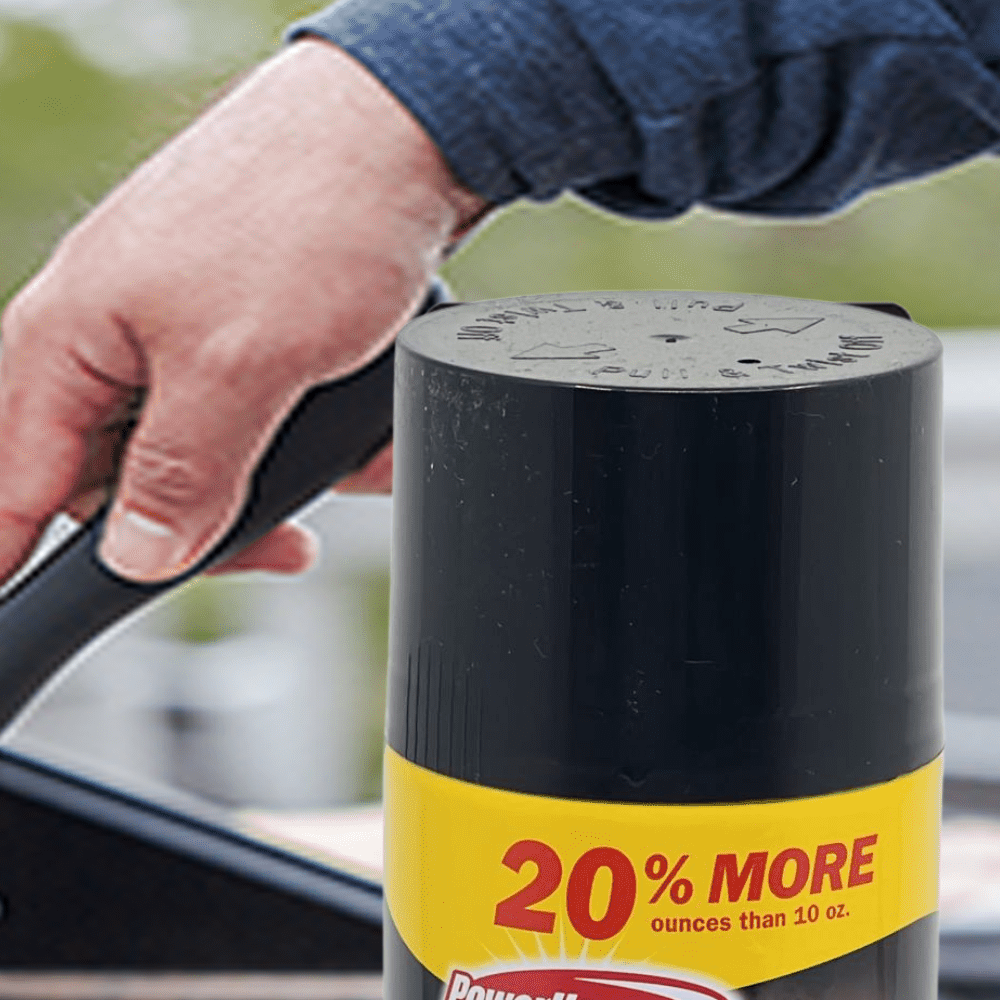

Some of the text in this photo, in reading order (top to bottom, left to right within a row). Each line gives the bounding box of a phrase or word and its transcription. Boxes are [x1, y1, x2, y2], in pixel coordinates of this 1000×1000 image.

[708, 834, 879, 904] MORE
[650, 902, 851, 934] ounces than 10 oz.
